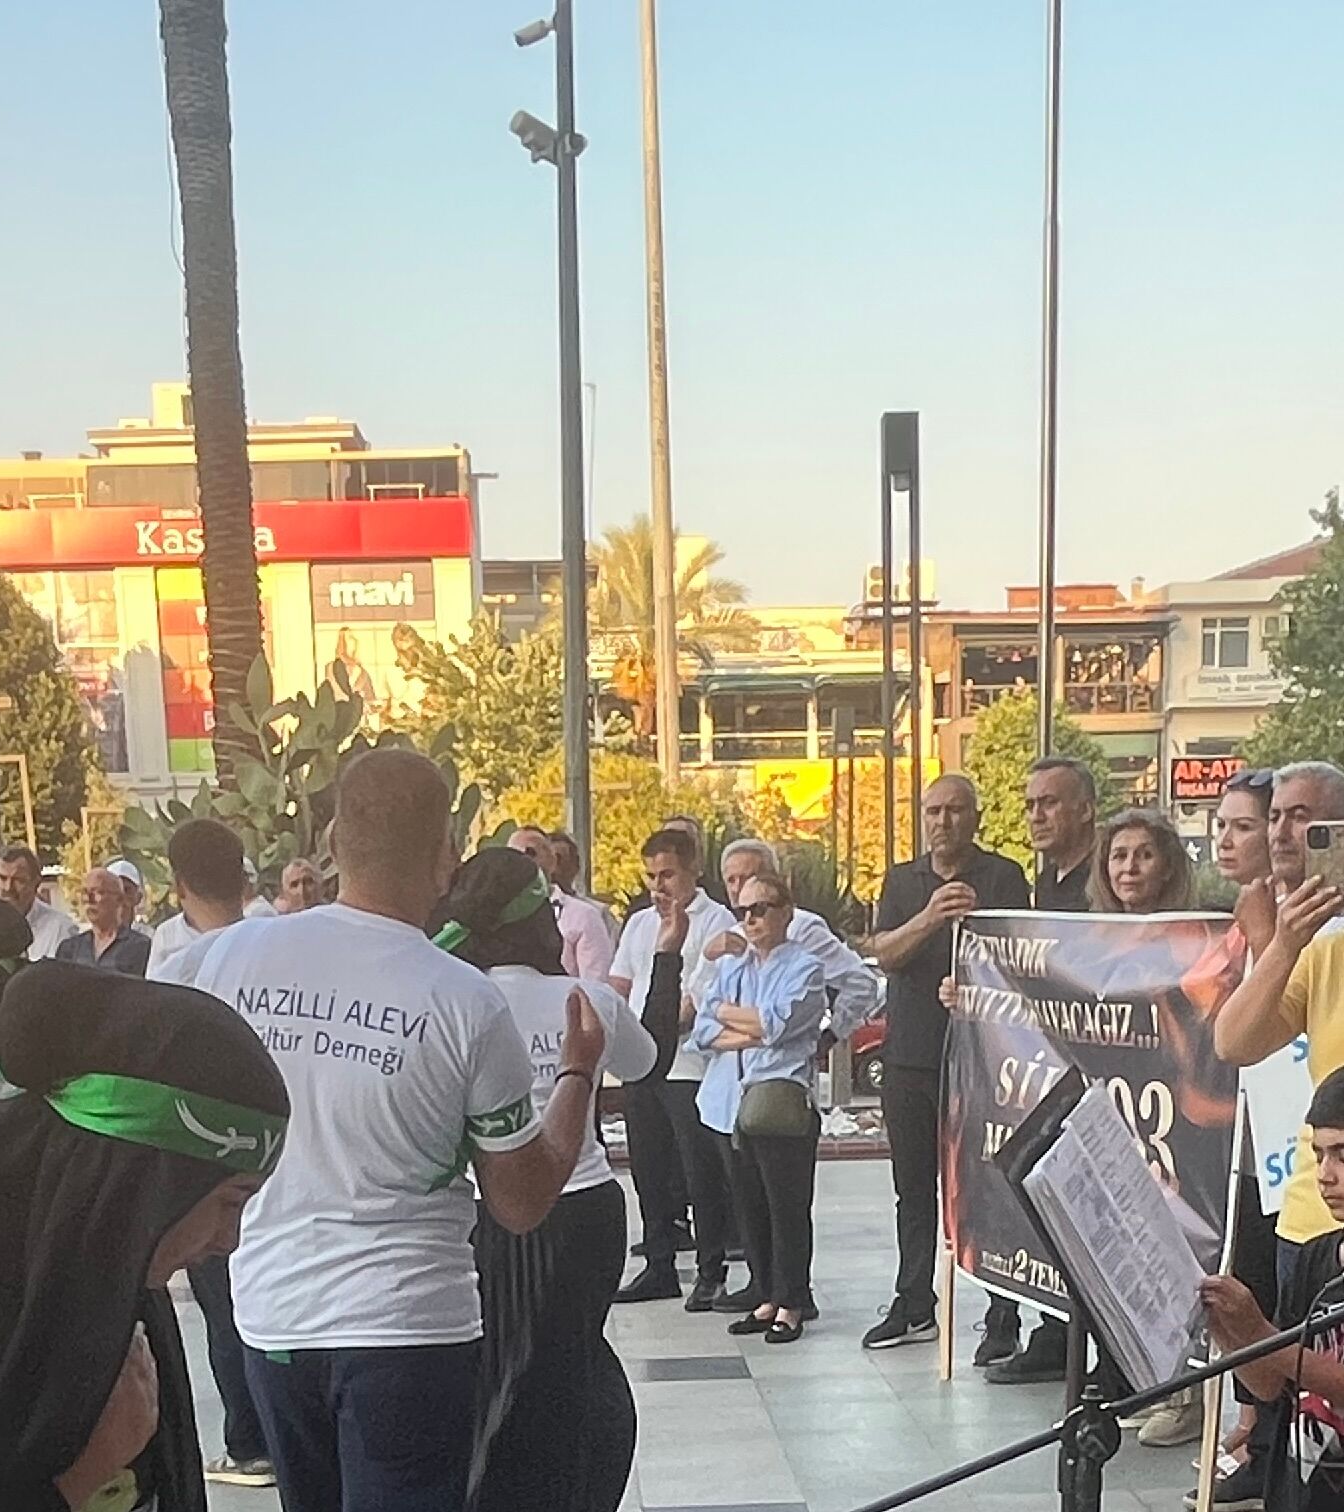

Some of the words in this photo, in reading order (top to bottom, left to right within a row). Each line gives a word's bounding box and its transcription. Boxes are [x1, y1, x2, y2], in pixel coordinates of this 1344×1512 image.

[329, 571, 415, 608] mavi
[235, 982, 338, 1022] NAZİLLİ
[342, 999, 431, 1044] ALEVİ
[313, 1030, 405, 1076] Derneği
